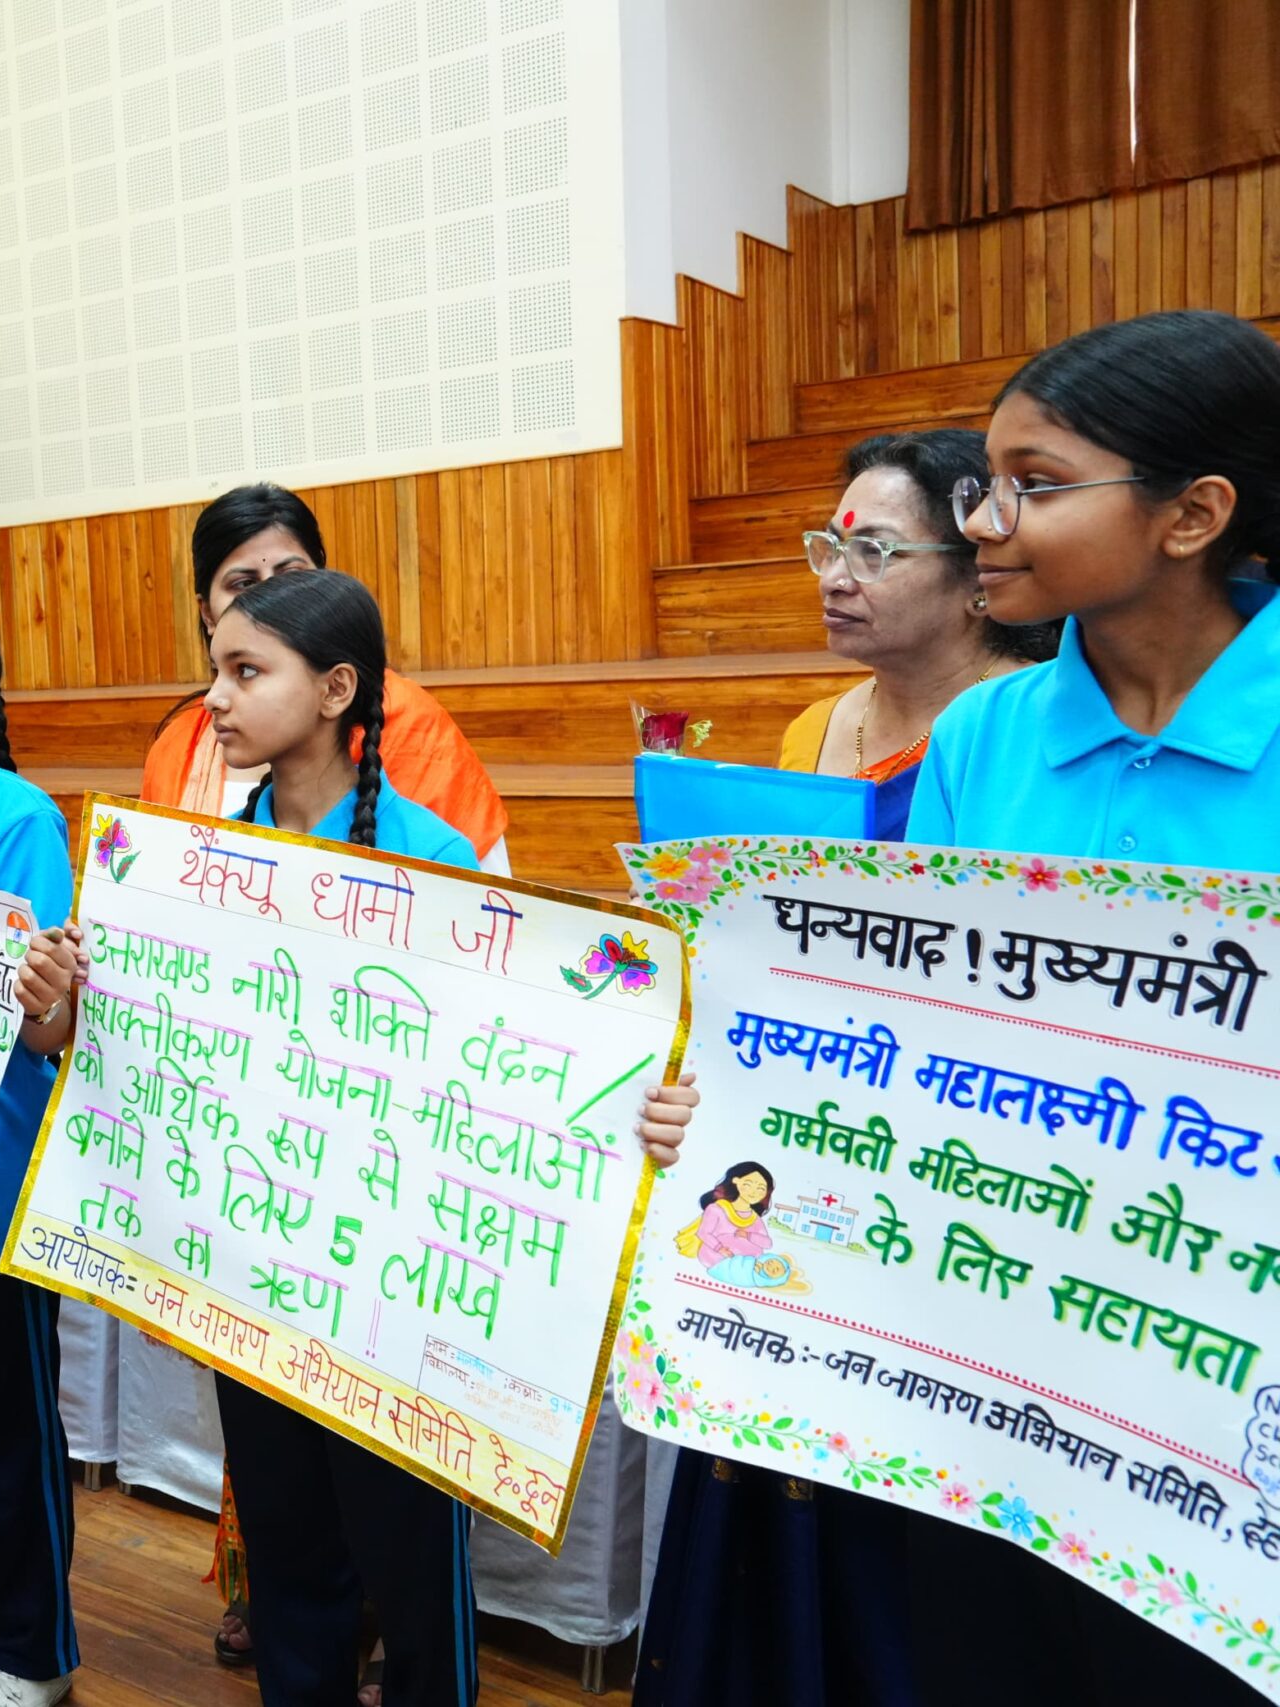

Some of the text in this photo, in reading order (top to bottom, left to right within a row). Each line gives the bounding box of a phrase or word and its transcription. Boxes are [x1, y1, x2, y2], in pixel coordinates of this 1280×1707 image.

[311, 866, 415, 950] धामी
[452, 889, 523, 975] जी
[991, 930, 1269, 1032] मुख्यमंत्री
[232, 948, 303, 1025] नारी
[461, 1016, 579, 1104] वंदन
[727, 1011, 1264, 1178] मुख्यमंत्री महालक्ष्मी किट
[66, 1106, 506, 1340] बनाने के लिए 5 लाख
[121, 1056, 239, 1141] आर्थिक
[358, 1128, 402, 1210] से
[428, 1170, 570, 1288] सक्षम
[759, 1100, 898, 1174] गर्भवती
[908, 1138, 1094, 1233] महिलाओं
[1111, 1182, 1222, 1273] और
[80, 1182, 142, 1238] तक
[174, 1221, 213, 1279] का
[248, 1257, 349, 1338] ऋण
[865, 1193, 1262, 1393] के लिए सहायता
[144, 1279, 189, 1327] जन
[189, 1302, 270, 1371] जागरण
[278, 1338, 384, 1429] अभियान
[388, 1395, 477, 1481] समिति
[825, 1349, 877, 1386] जन
[876, 1368, 985, 1425] जागरण
[984, 1400, 1124, 1483] अभियान
